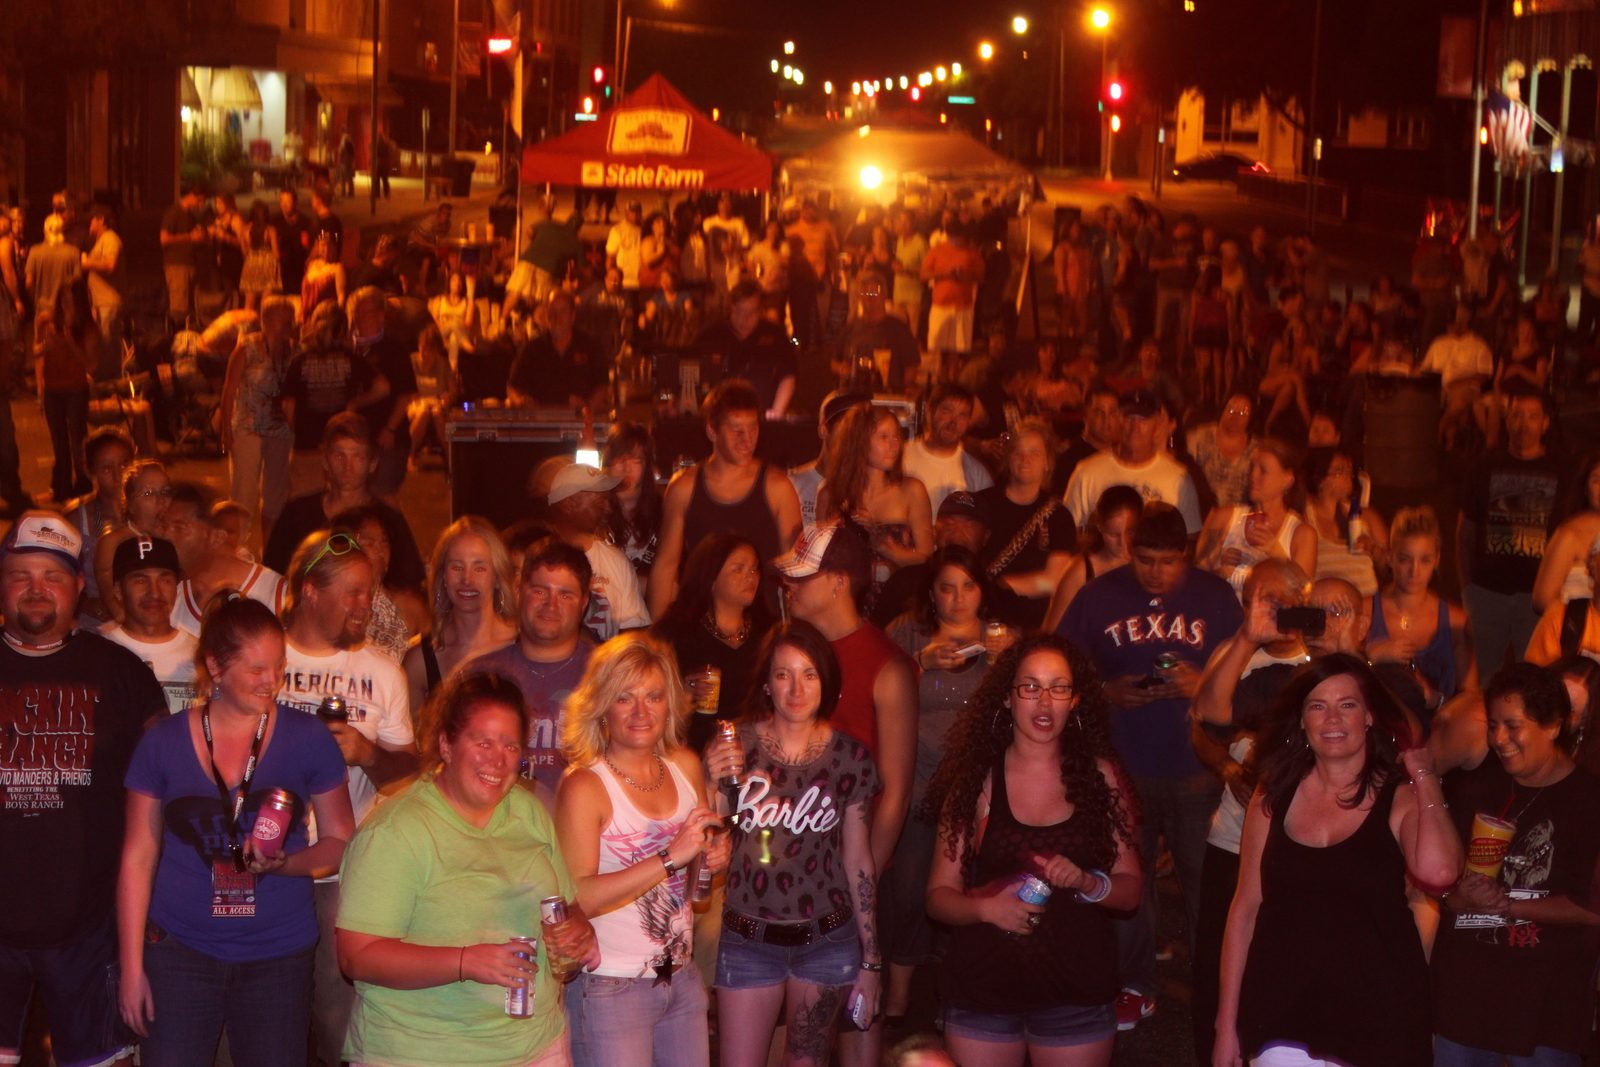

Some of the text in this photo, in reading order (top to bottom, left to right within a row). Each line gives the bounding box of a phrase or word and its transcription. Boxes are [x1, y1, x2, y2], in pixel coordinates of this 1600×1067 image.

[139, 541, 153, 560] P
[1104, 613, 1204, 648] TEXAS
[284, 671, 373, 701] MERICAN
[13, 771, 52, 785] MANDERS
[53, 771, 60, 785] &
[60, 771, 92, 786] FRIENDS
[5, 801, 64, 809] BOYS RANCH
[736, 775, 840, 835] Barbie
[212, 907, 256, 915] ALL ACCESS
